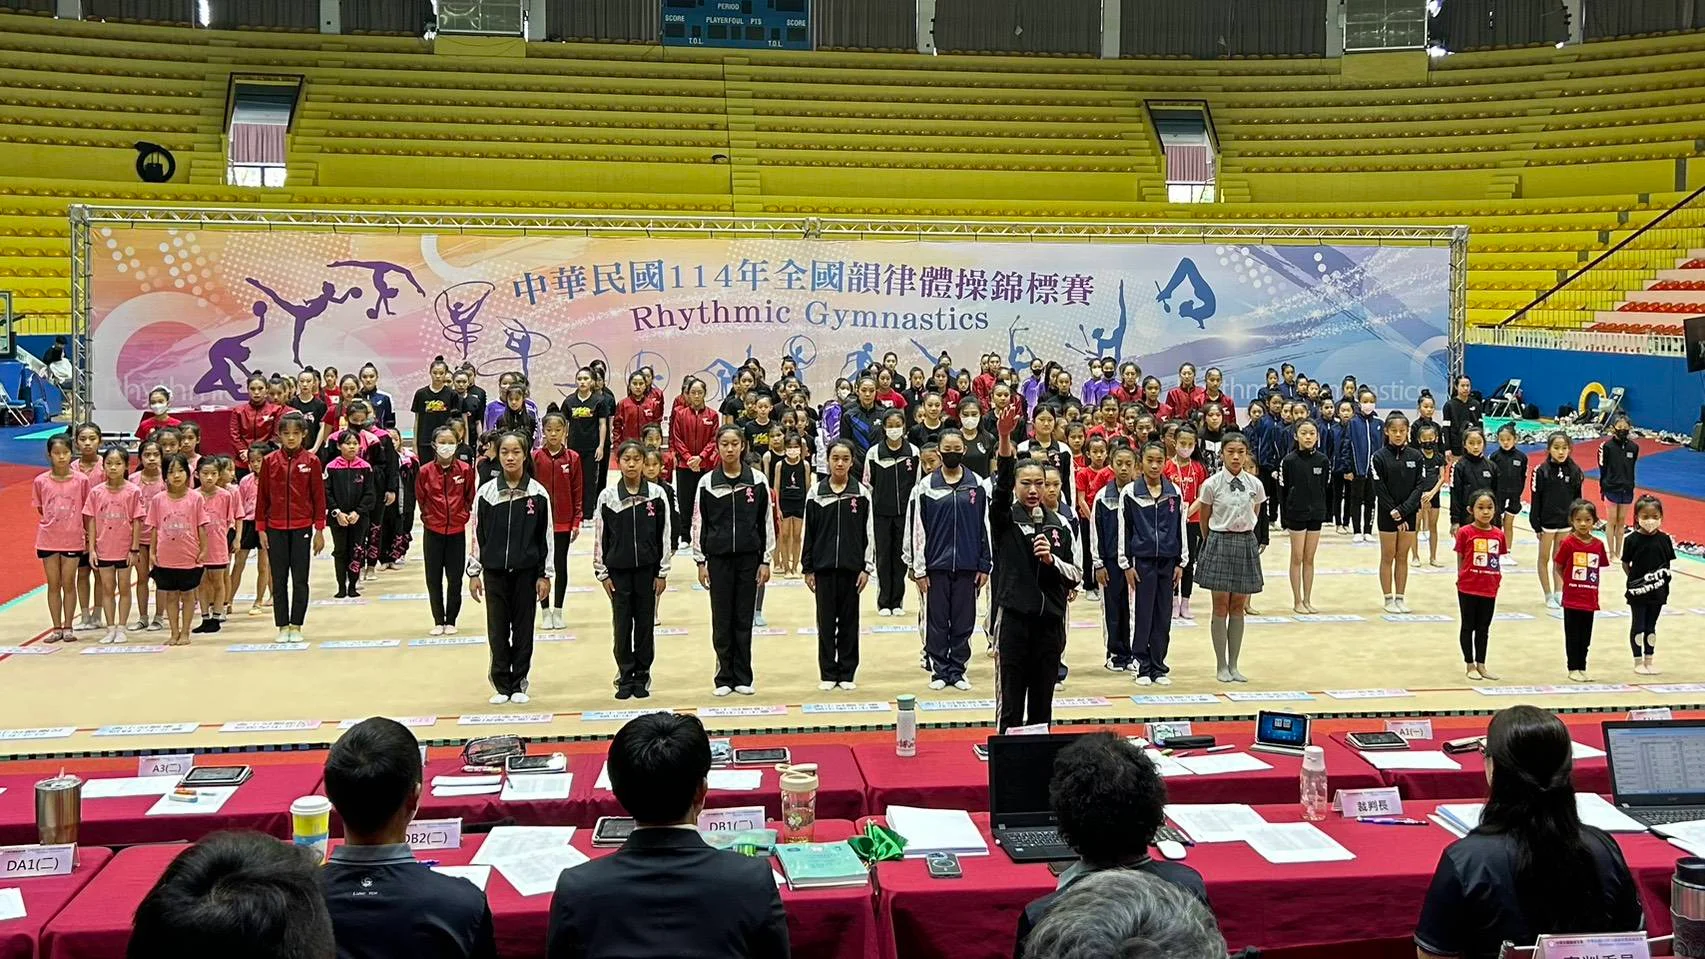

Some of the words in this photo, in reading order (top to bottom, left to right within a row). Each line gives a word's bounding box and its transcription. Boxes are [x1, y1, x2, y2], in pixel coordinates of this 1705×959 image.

[717, 2, 740, 10] PERIOD
[664, 14, 685, 22] SCORE
[705, 16, 728, 24] PLAYER
[728, 17, 744, 25] FOUL
[786, 18, 806, 27] SCORE
[512, 258, 1095, 306] 中華民國114年全國韻律體操錦標賽
[630, 299, 791, 332] Rhythmic
[805, 300, 989, 331] Gymnastics
[152, 763, 182, 773] A3(二)
[6, 857, 59, 872] DA1(二)
